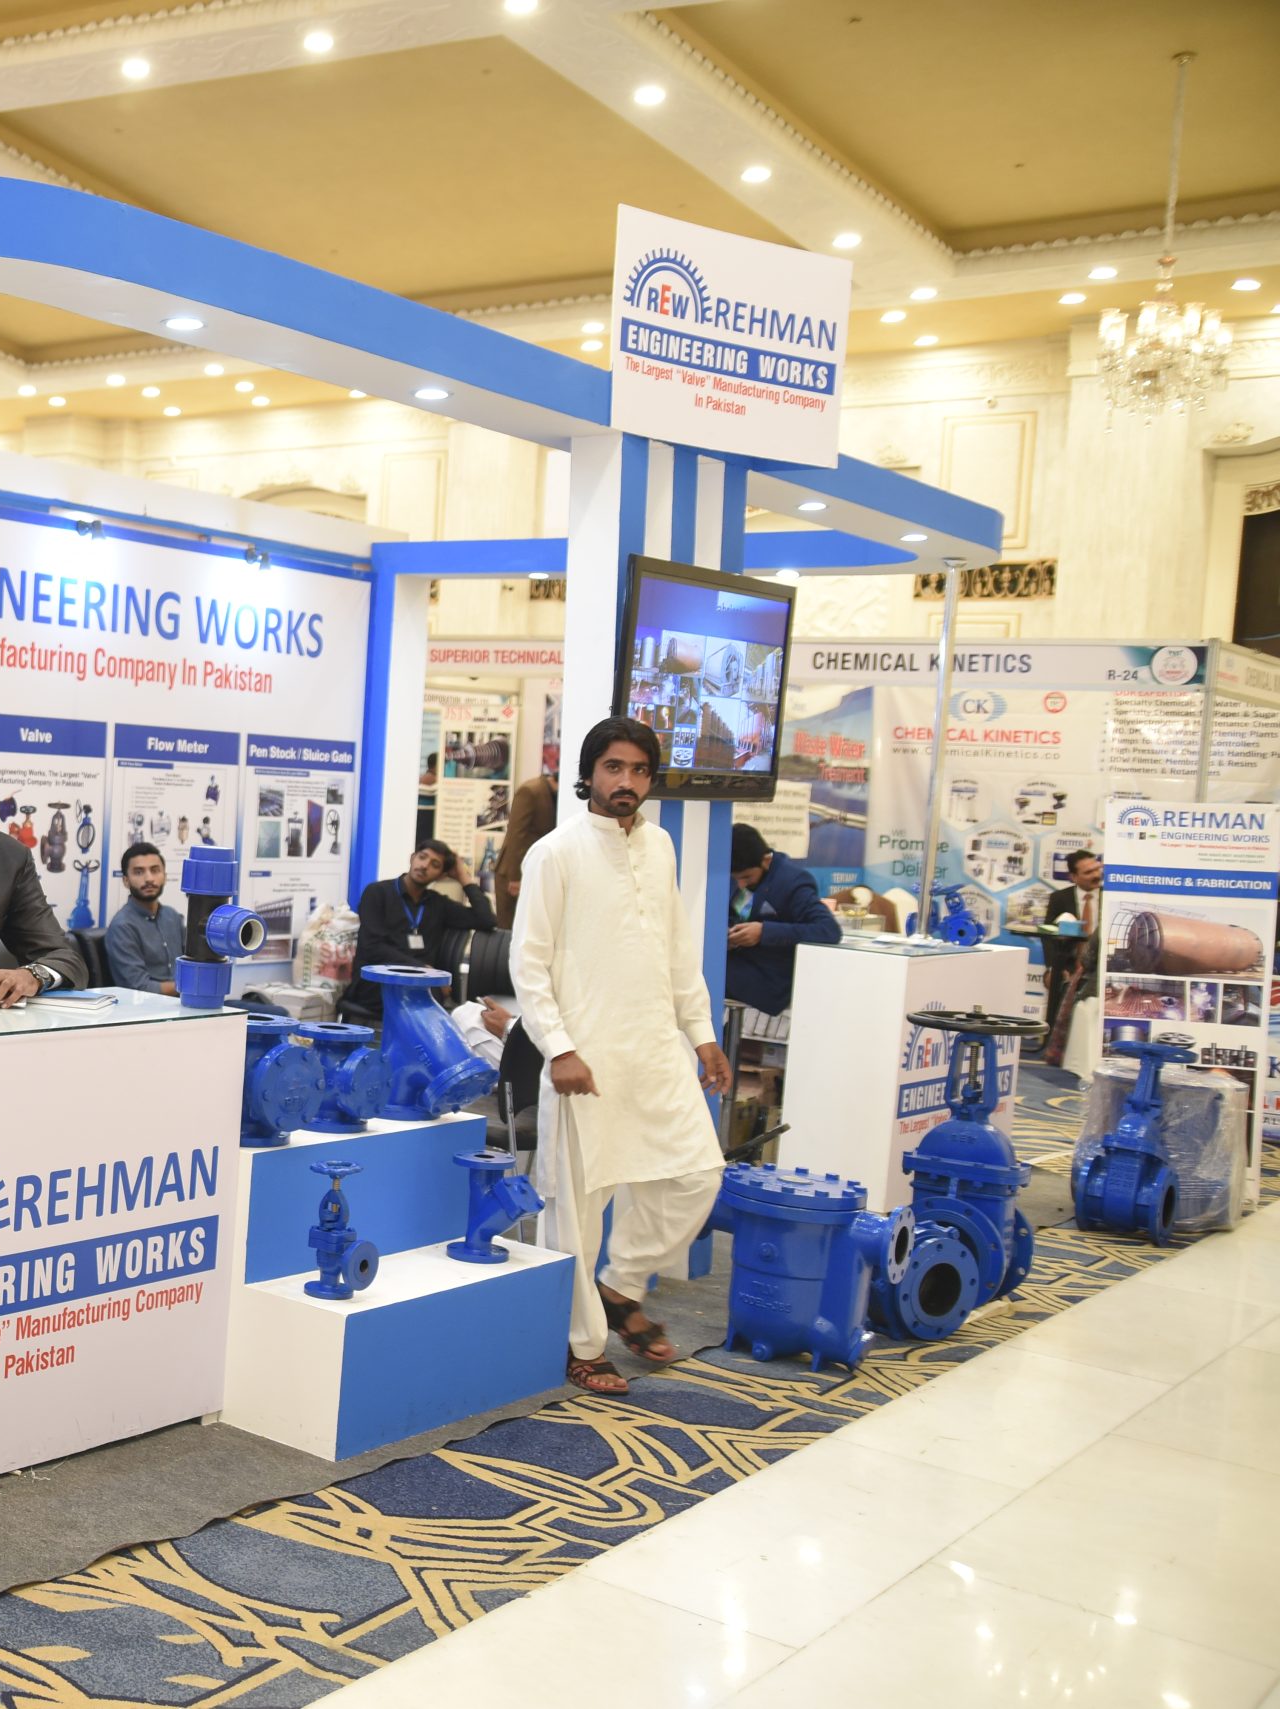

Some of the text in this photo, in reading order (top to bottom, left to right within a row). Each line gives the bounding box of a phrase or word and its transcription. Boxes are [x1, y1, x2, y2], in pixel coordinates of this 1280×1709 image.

[646, 283, 690, 320] REW
[714, 297, 838, 352] REHMAN
[627, 324, 829, 390] ENGINEERING WORKS
[625, 355, 640, 372] The
[641, 359, 673, 382] Largest
[712, 376, 780, 404] Manufacturing
[782, 389, 827, 413] Company
[694, 393, 747, 416] In Pakistan
[194, 596, 324, 659] WORKS
[430, 649, 564, 665] SUPERIOR TECHNICAL
[812, 651, 1033, 673] CHEMICAL KNETICS
[93, 647, 179, 691] Company
[181, 661, 198, 688] In
[202, 660, 273, 694] Pakistan
[1107, 669, 1139, 681] R-24
[962, 698, 989, 715] CK
[19, 727, 53, 743] Valve
[147, 737, 210, 754] Flow Meter
[983, 730, 1062, 745] KINETICS
[249, 743, 269, 758] Pen
[270, 745, 297, 760] Stock
[302, 748, 330, 762] Sluice
[331, 750, 353, 764] Gate
[27, 778, 52, 787] Company
[60, 771, 80, 779] Largest
[1127, 815, 1151, 827] REW
[1163, 810, 1266, 831] REHMAN
[1160, 831, 1270, 844] ENGINEERING WORKS
[892, 860, 949, 879] Delier
[1108, 872, 1272, 891] ENGINEERING & FABRICATION
[900, 1121, 909, 1134] The
[13, 1145, 220, 1232] REHMAN
[95, 1226, 207, 1285] WORKS
[15, 1296, 131, 1342] Manufacturing
[134, 1280, 204, 1314] Company
[4, 1344, 76, 1380] Pakistan
